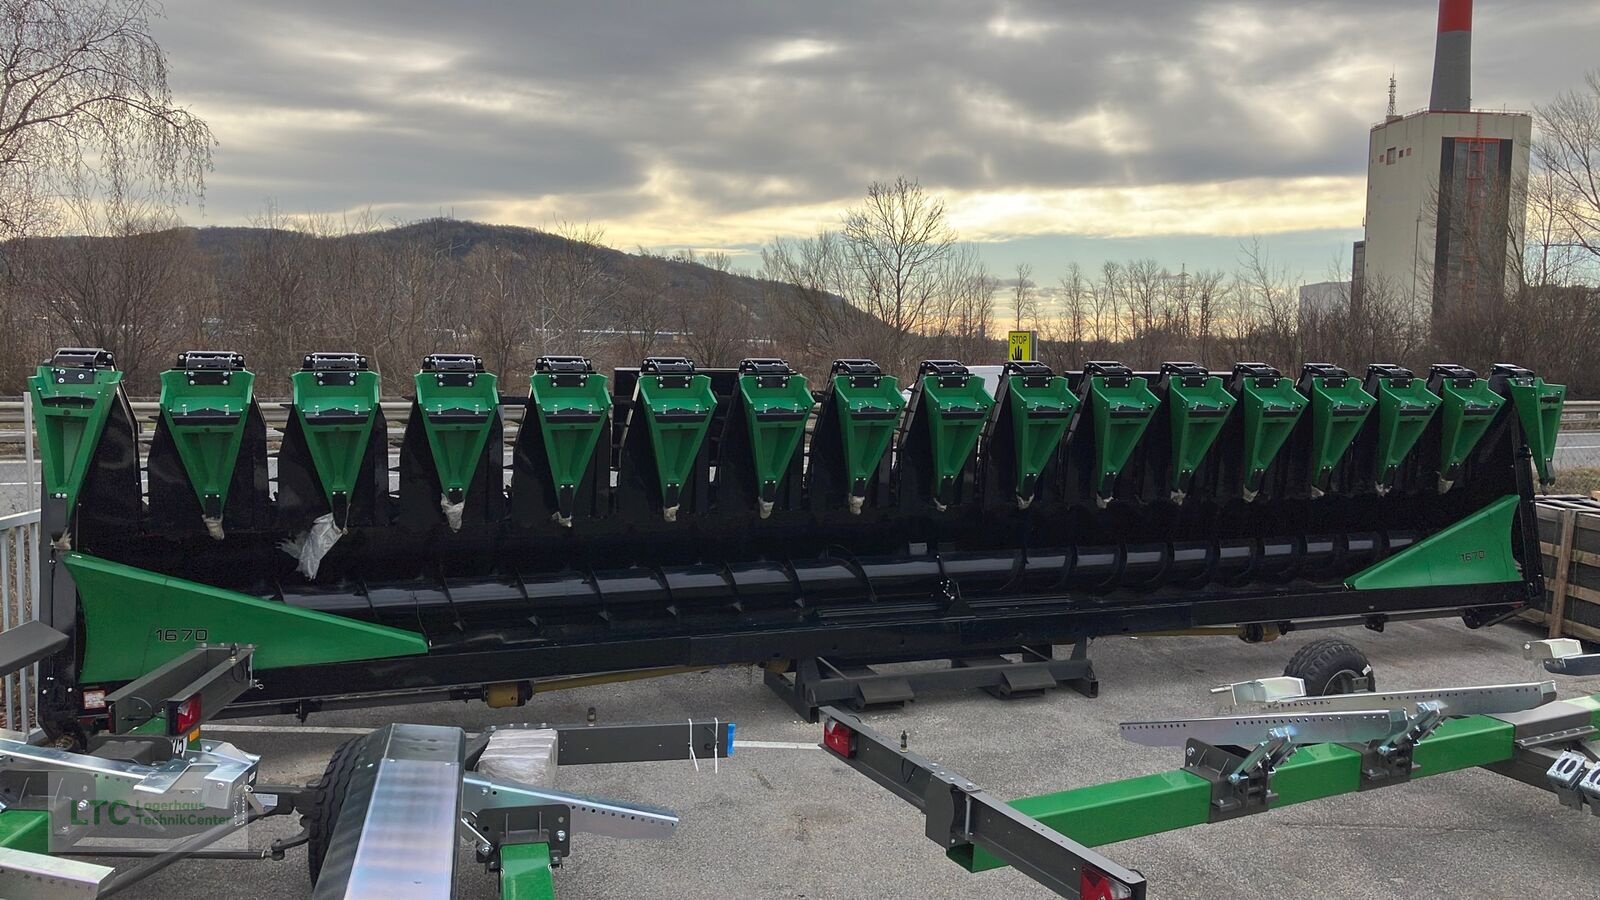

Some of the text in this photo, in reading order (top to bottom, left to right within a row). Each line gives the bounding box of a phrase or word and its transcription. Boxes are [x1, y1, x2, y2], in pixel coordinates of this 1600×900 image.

[1011, 335, 1027, 344] STOP
[1461, 550, 1485, 561] 1670
[155, 629, 208, 641] 1670
